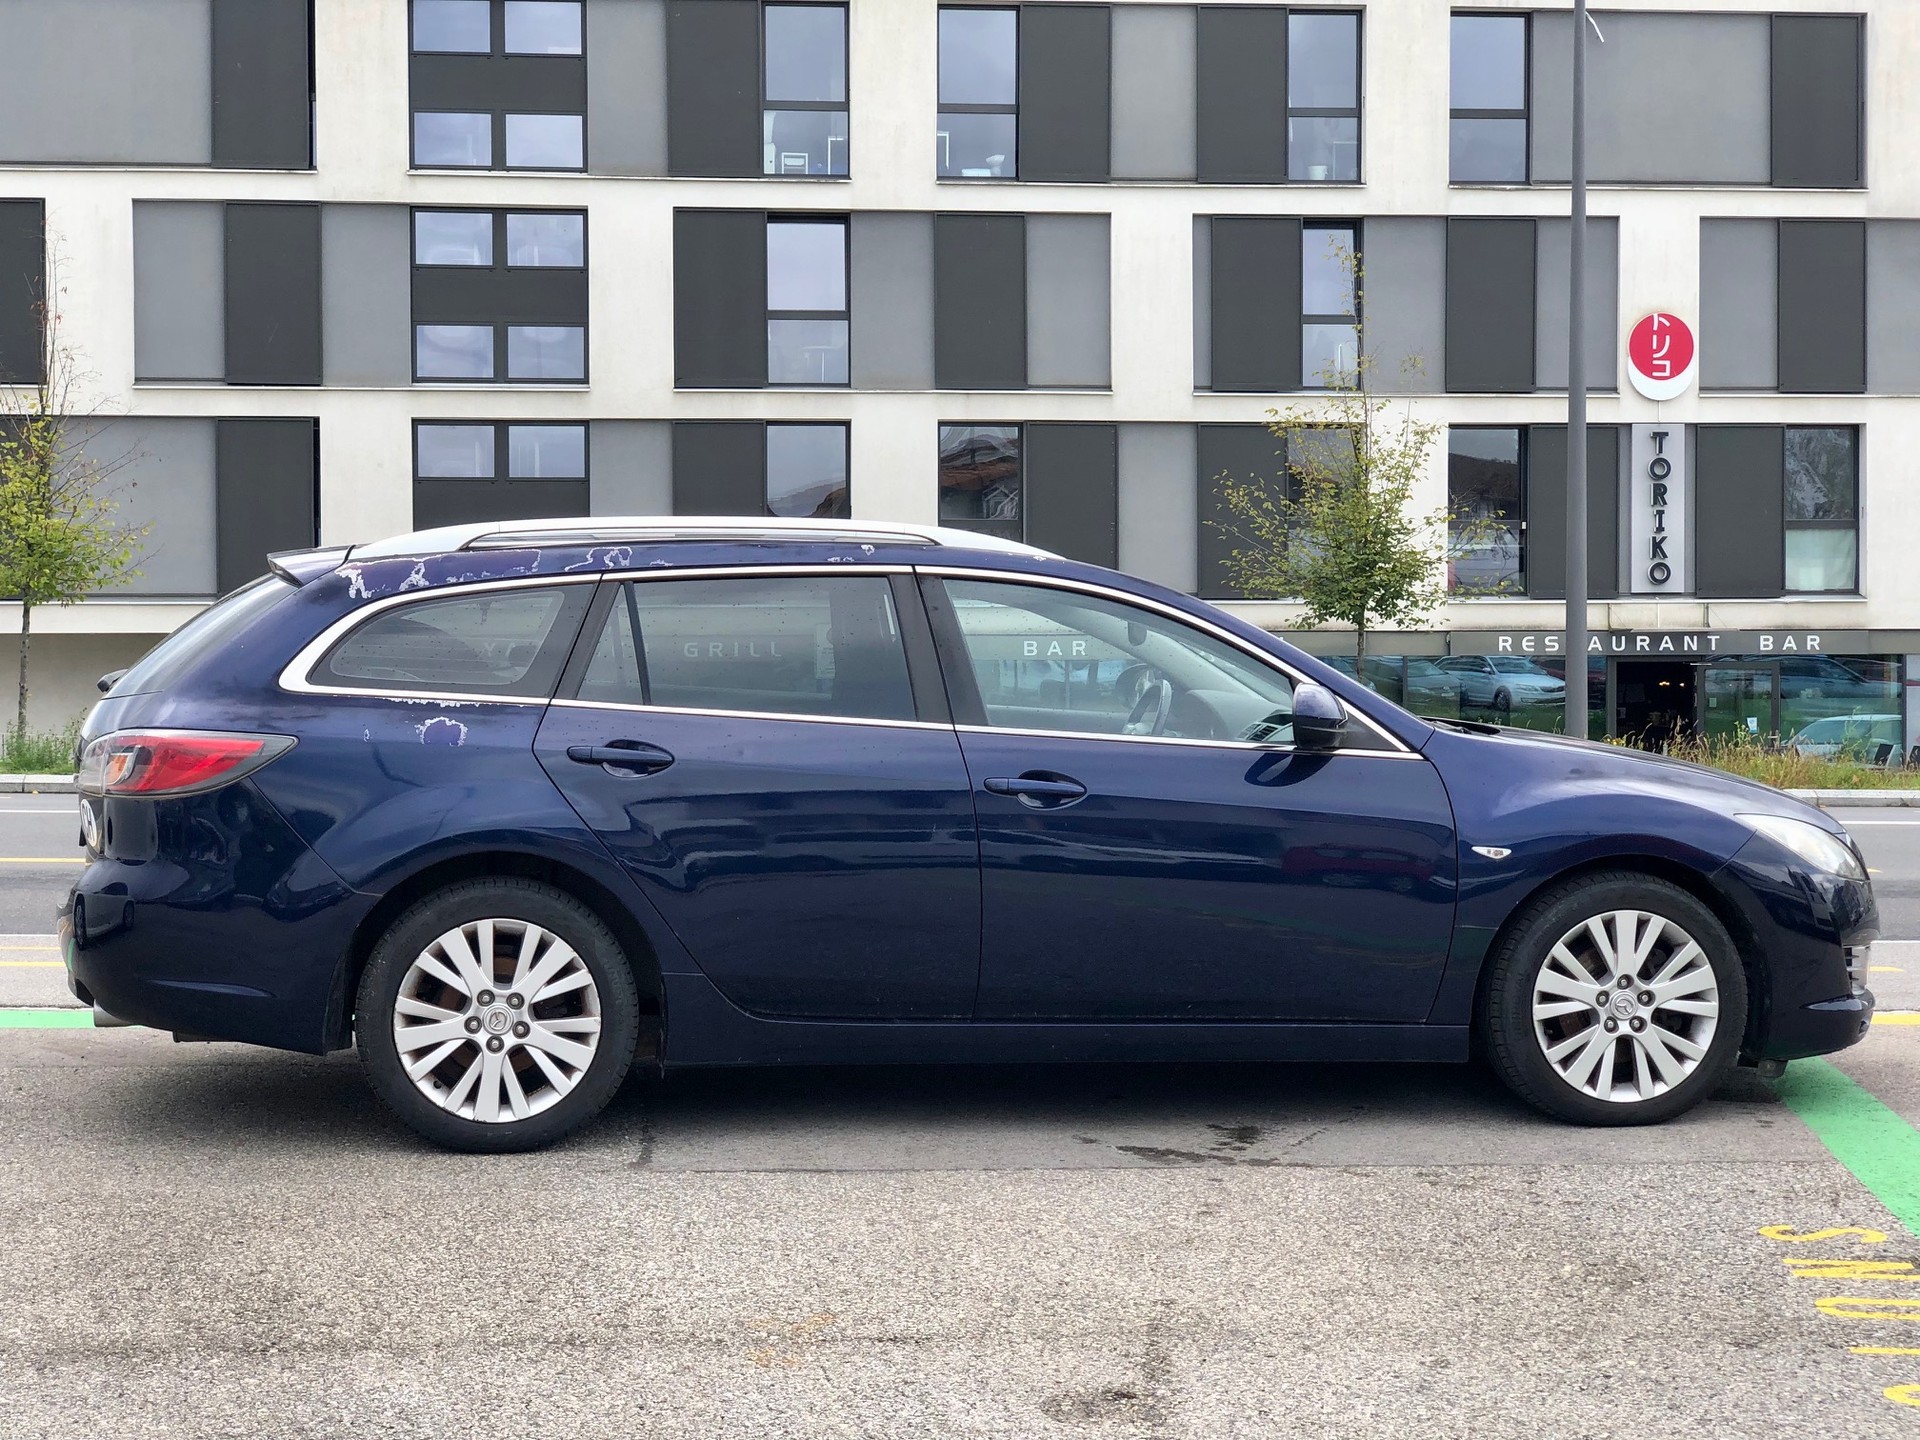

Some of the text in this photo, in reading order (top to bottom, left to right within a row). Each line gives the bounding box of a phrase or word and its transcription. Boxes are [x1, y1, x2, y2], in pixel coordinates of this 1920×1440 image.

[1651, 313, 1671, 377] トリコ
[1647, 431, 1672, 585] TORIKO
[683, 639, 1088, 658] GRILL BAR
[1498, 634, 1822, 652] RESAURANT BAR
